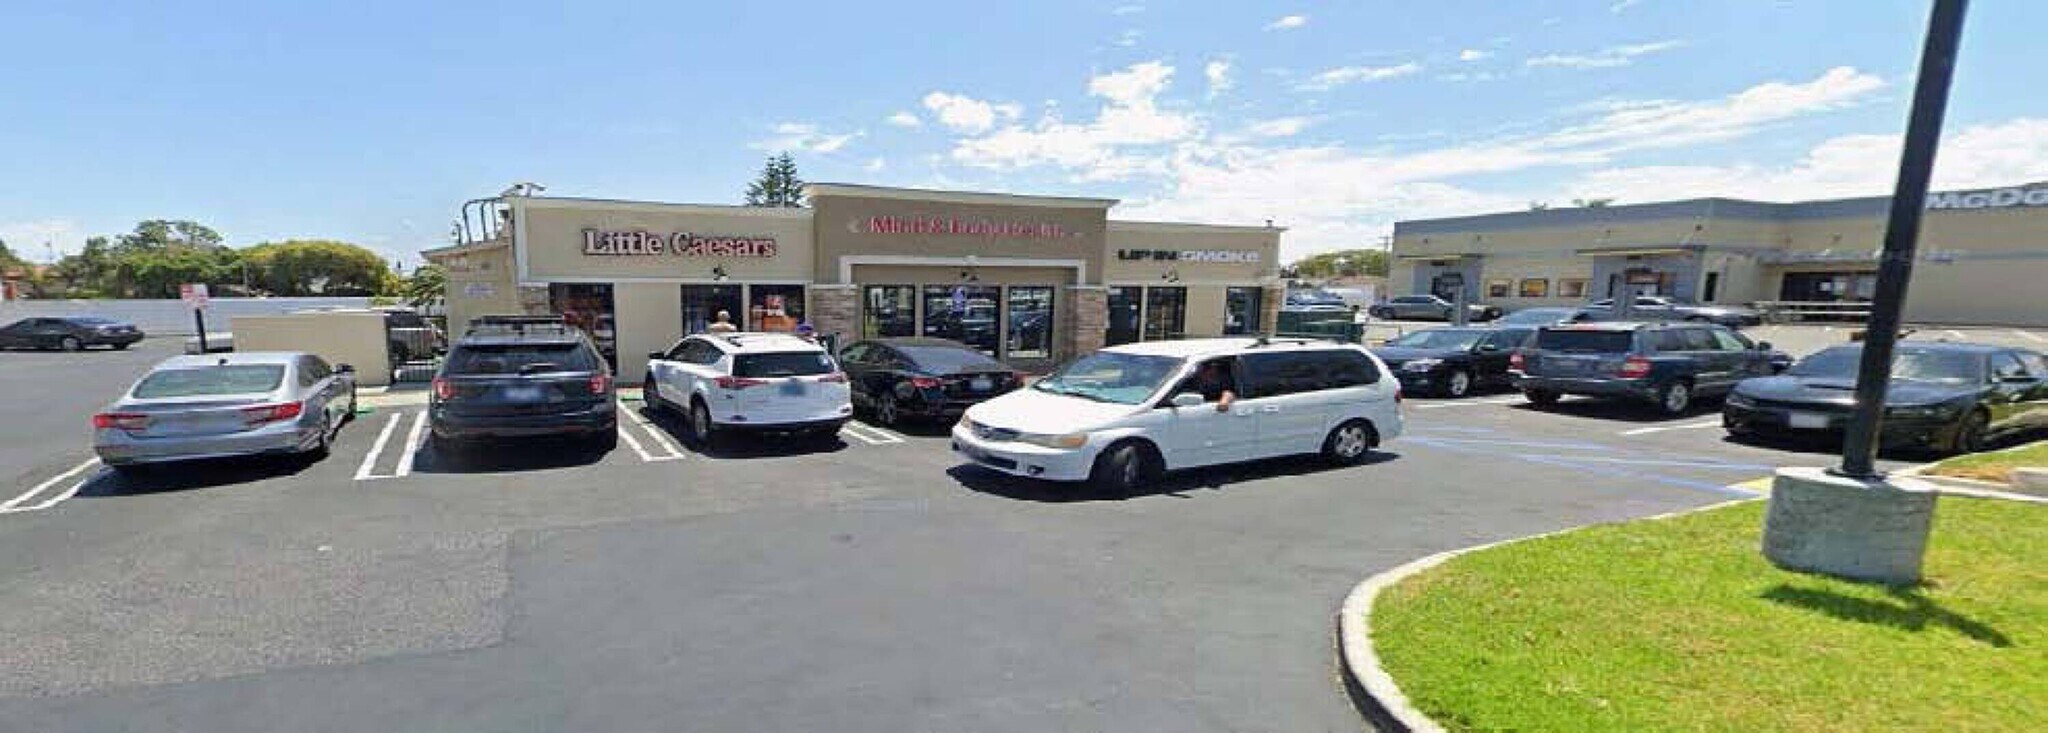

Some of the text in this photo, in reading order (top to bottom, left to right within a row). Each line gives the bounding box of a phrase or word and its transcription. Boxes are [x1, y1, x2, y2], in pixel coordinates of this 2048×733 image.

[930, 216, 944, 233] &
[583, 229, 777, 258] Little Caesars
[1118, 249, 1263, 263] UP IN SMOKE
